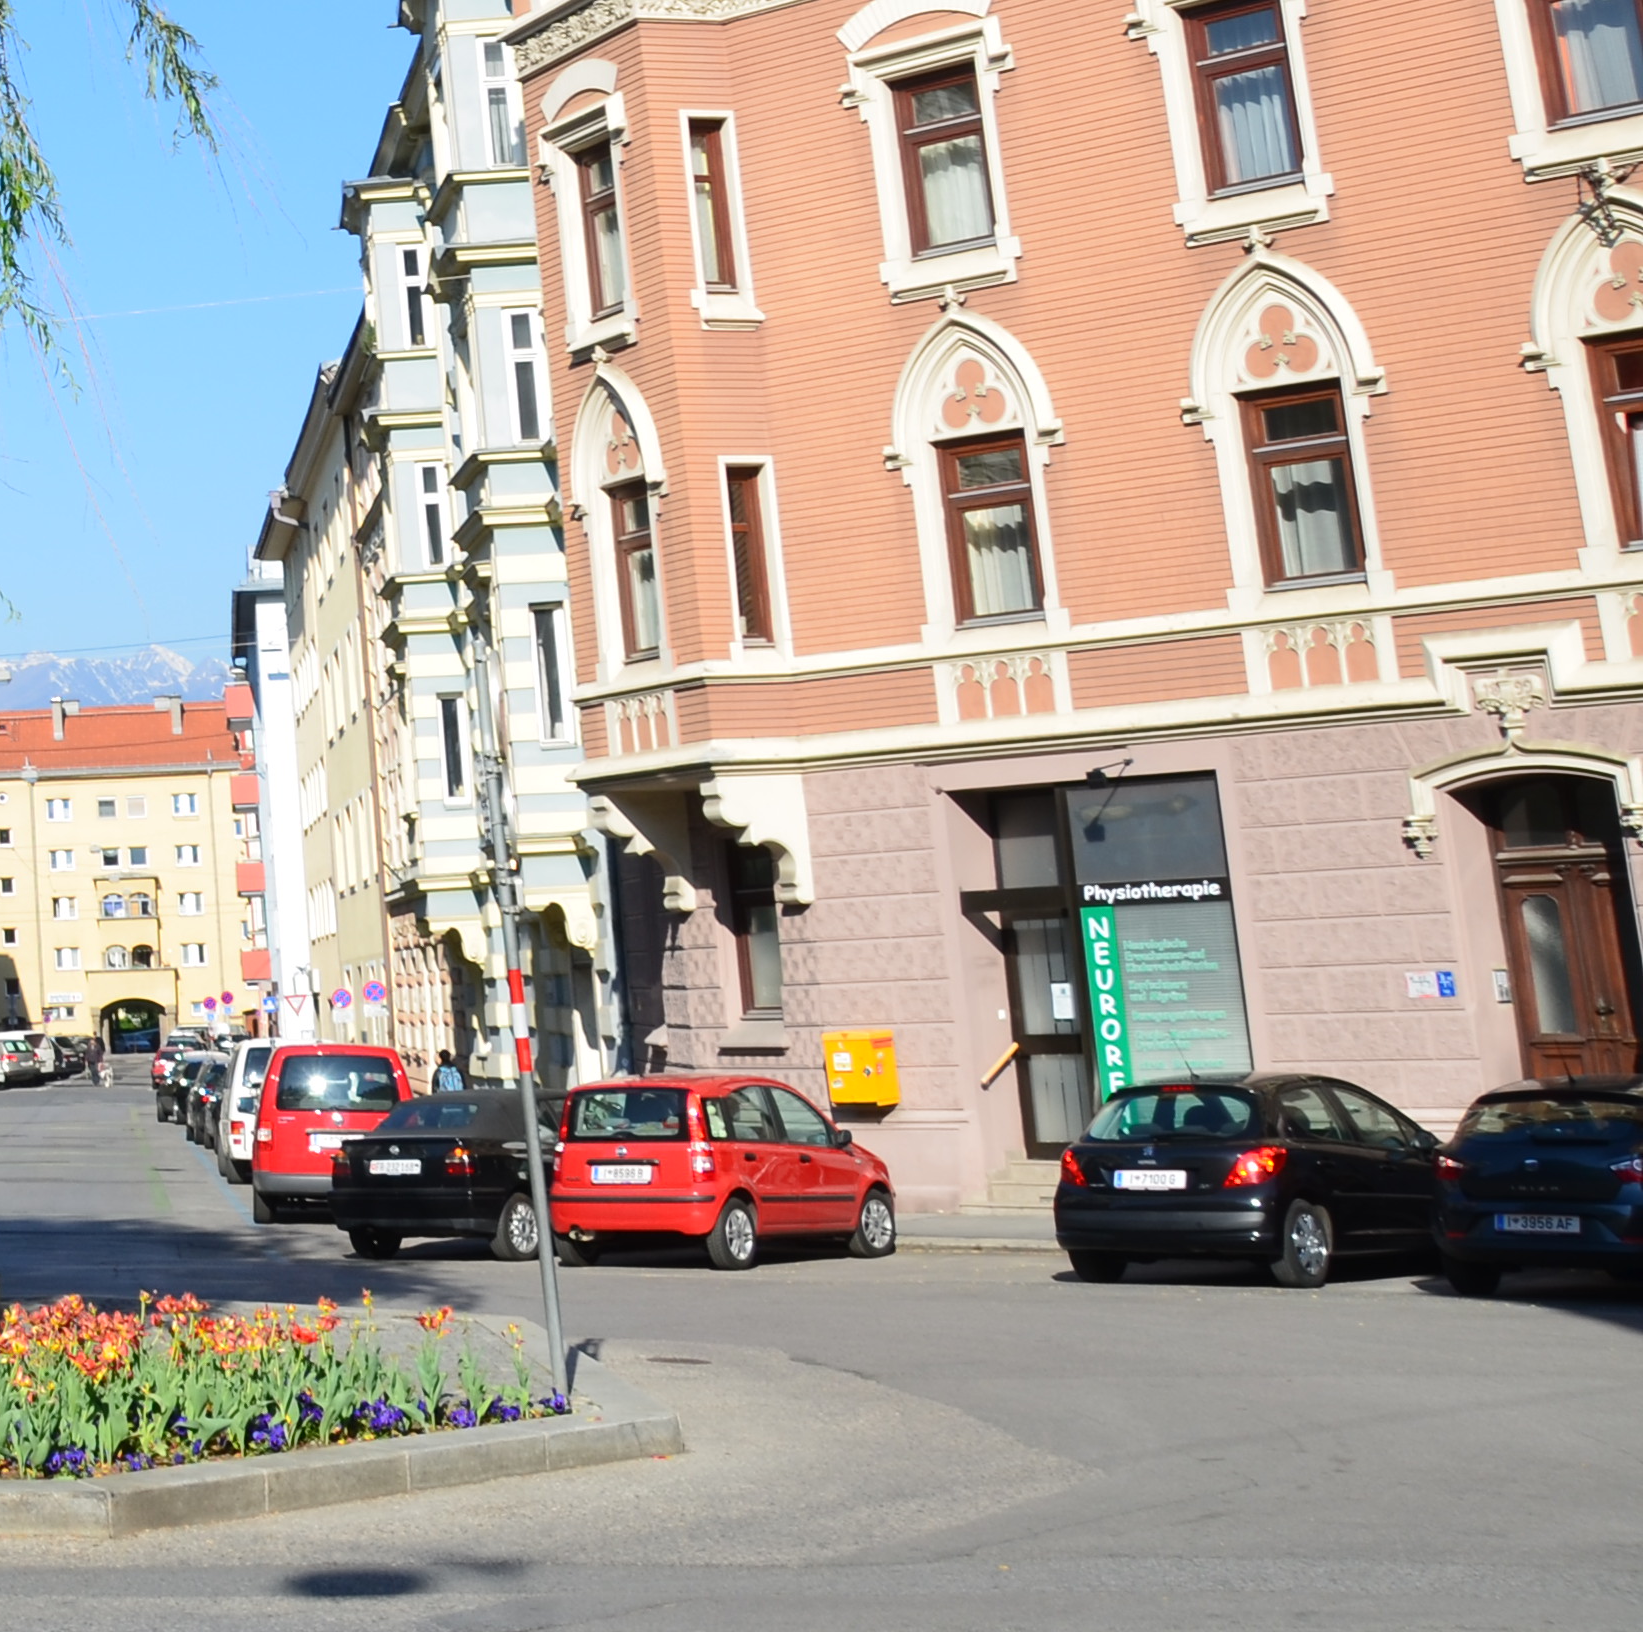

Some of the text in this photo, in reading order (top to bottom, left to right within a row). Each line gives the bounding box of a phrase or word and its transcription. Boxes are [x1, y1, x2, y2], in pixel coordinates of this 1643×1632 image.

[1083, 880, 1223, 904] Physiotherapie
[1521, 1216, 1554, 1229] 3956
[1555, 1218, 1573, 1230] AF
